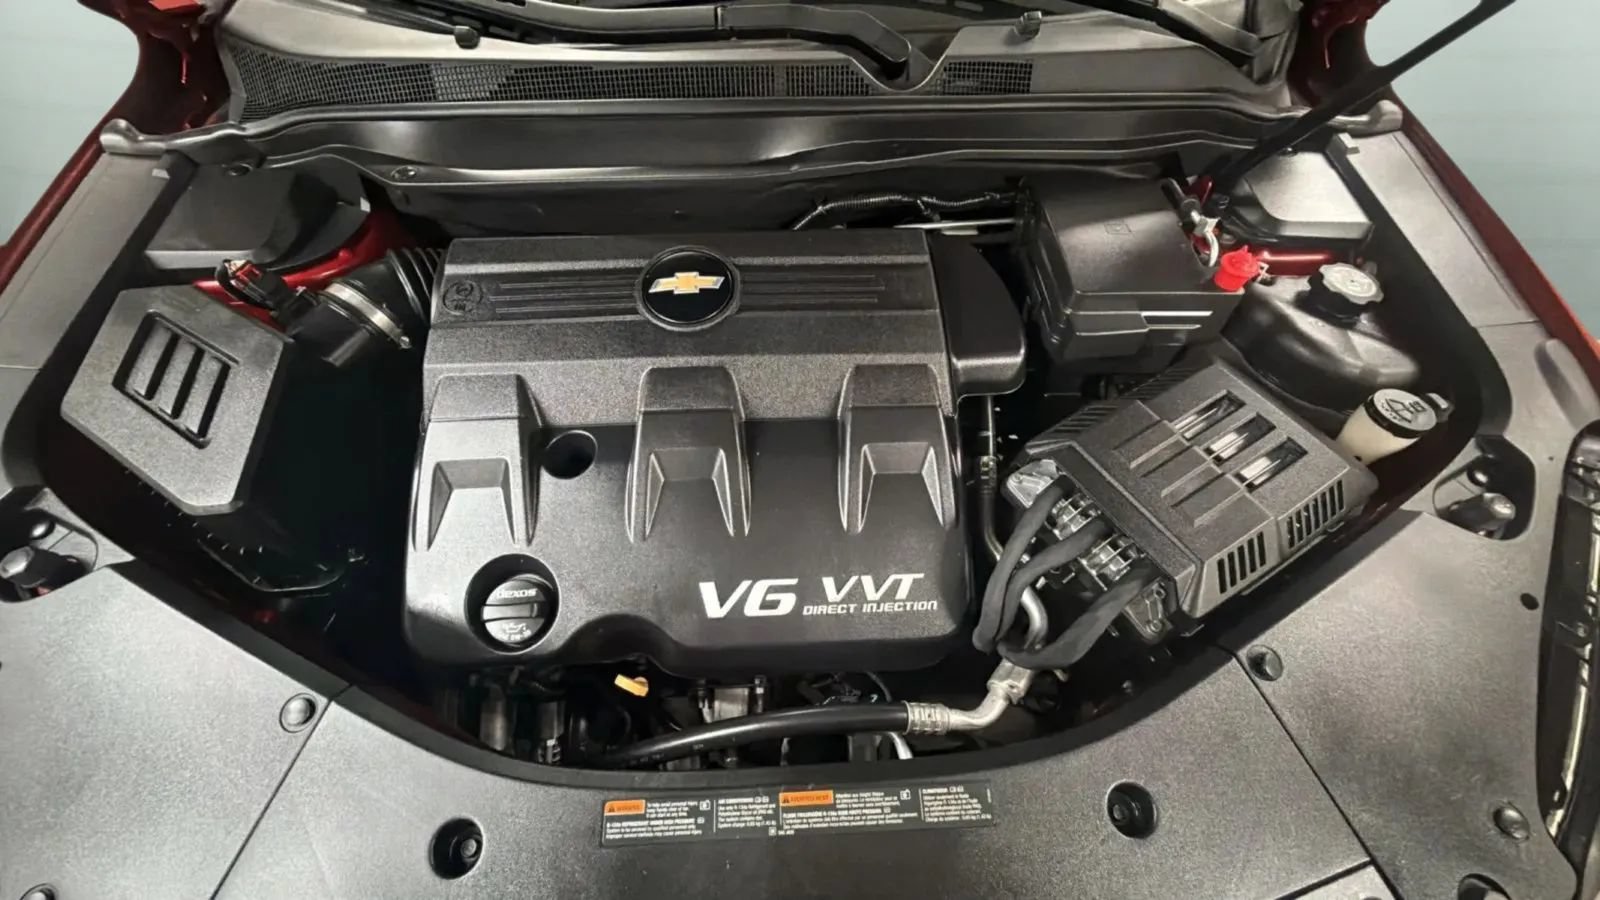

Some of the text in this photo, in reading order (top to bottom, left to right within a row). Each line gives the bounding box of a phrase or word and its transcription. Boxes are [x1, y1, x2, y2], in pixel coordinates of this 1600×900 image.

[698, 573, 925, 619] V6 VVT
[802, 600, 938, 616] DIRECT INJECTION
